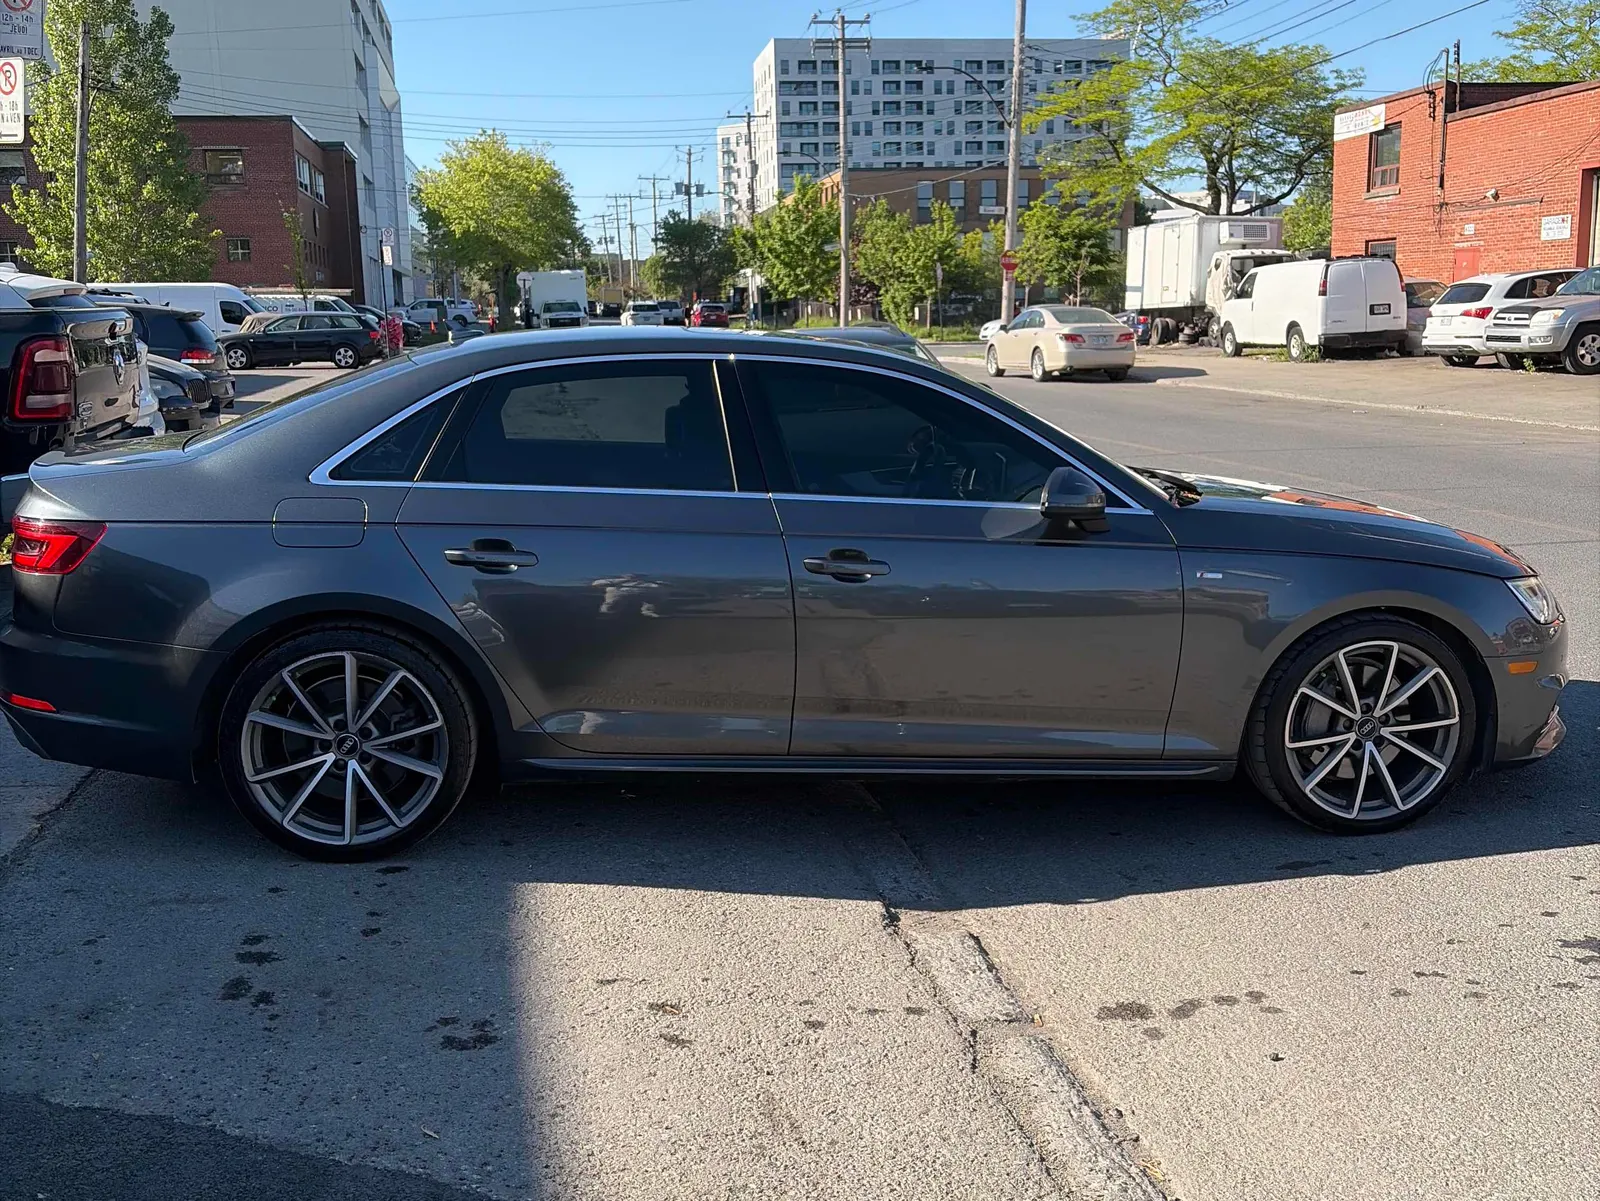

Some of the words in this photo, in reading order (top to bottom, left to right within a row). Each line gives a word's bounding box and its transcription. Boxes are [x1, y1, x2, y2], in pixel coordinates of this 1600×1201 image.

[2, 13, 13, 21] 12h
[22, 14, 34, 23] 14h
[10, 24, 28, 34] JEUDI
